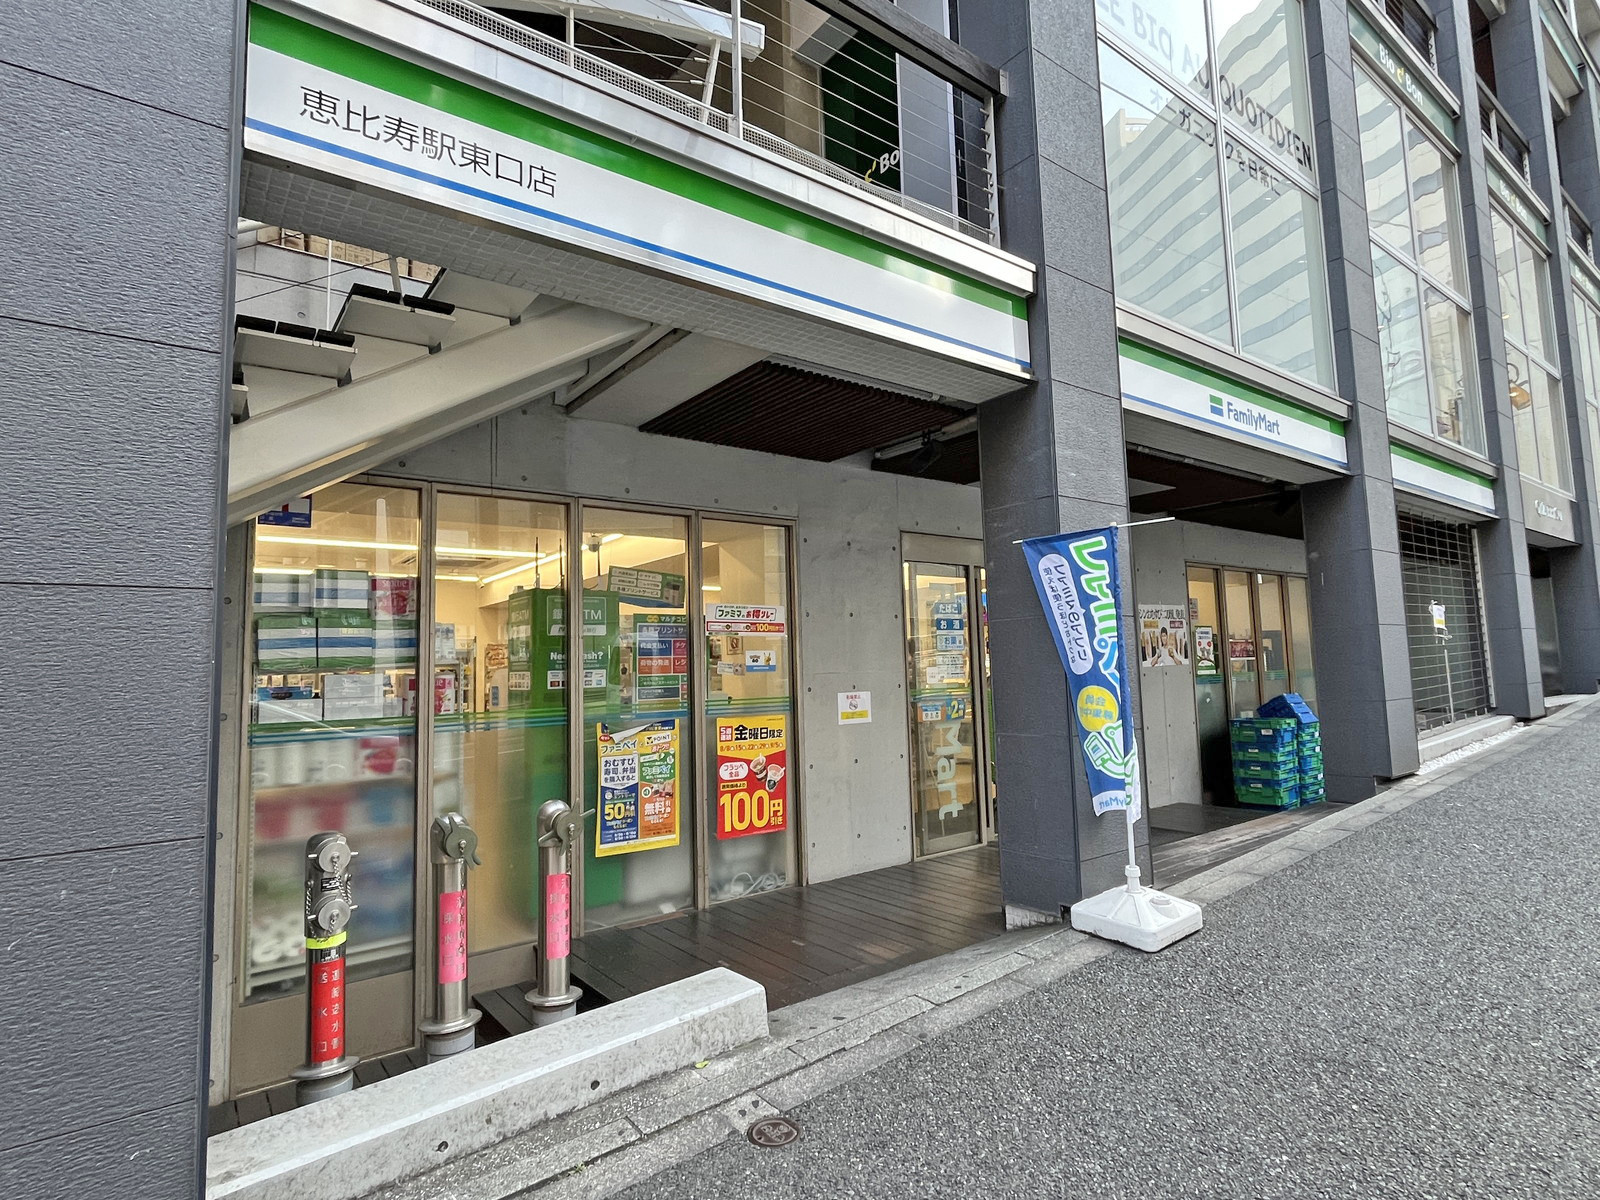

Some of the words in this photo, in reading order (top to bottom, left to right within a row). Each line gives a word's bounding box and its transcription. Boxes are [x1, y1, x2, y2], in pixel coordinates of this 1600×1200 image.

[1378, 43, 1396, 74] Bio
[1405, 72, 1424, 107] Bon
[1131, 1, 1172, 62] BIO
[1218, 74, 1314, 173] QUOTIDIEN
[299, 85, 558, 199] 恵比寿駅東口店
[1226, 400, 1281, 436] FamilyMart
[938, 602, 959, 615] たばこ
[940, 619, 961, 630] お酒
[734, 724, 784, 741] 金曜日限定
[600, 740, 638, 754] ファミペイ
[723, 763, 745, 771] フラッペ
[935, 722, 964, 820] Mart
[644, 802, 665, 815] 無料
